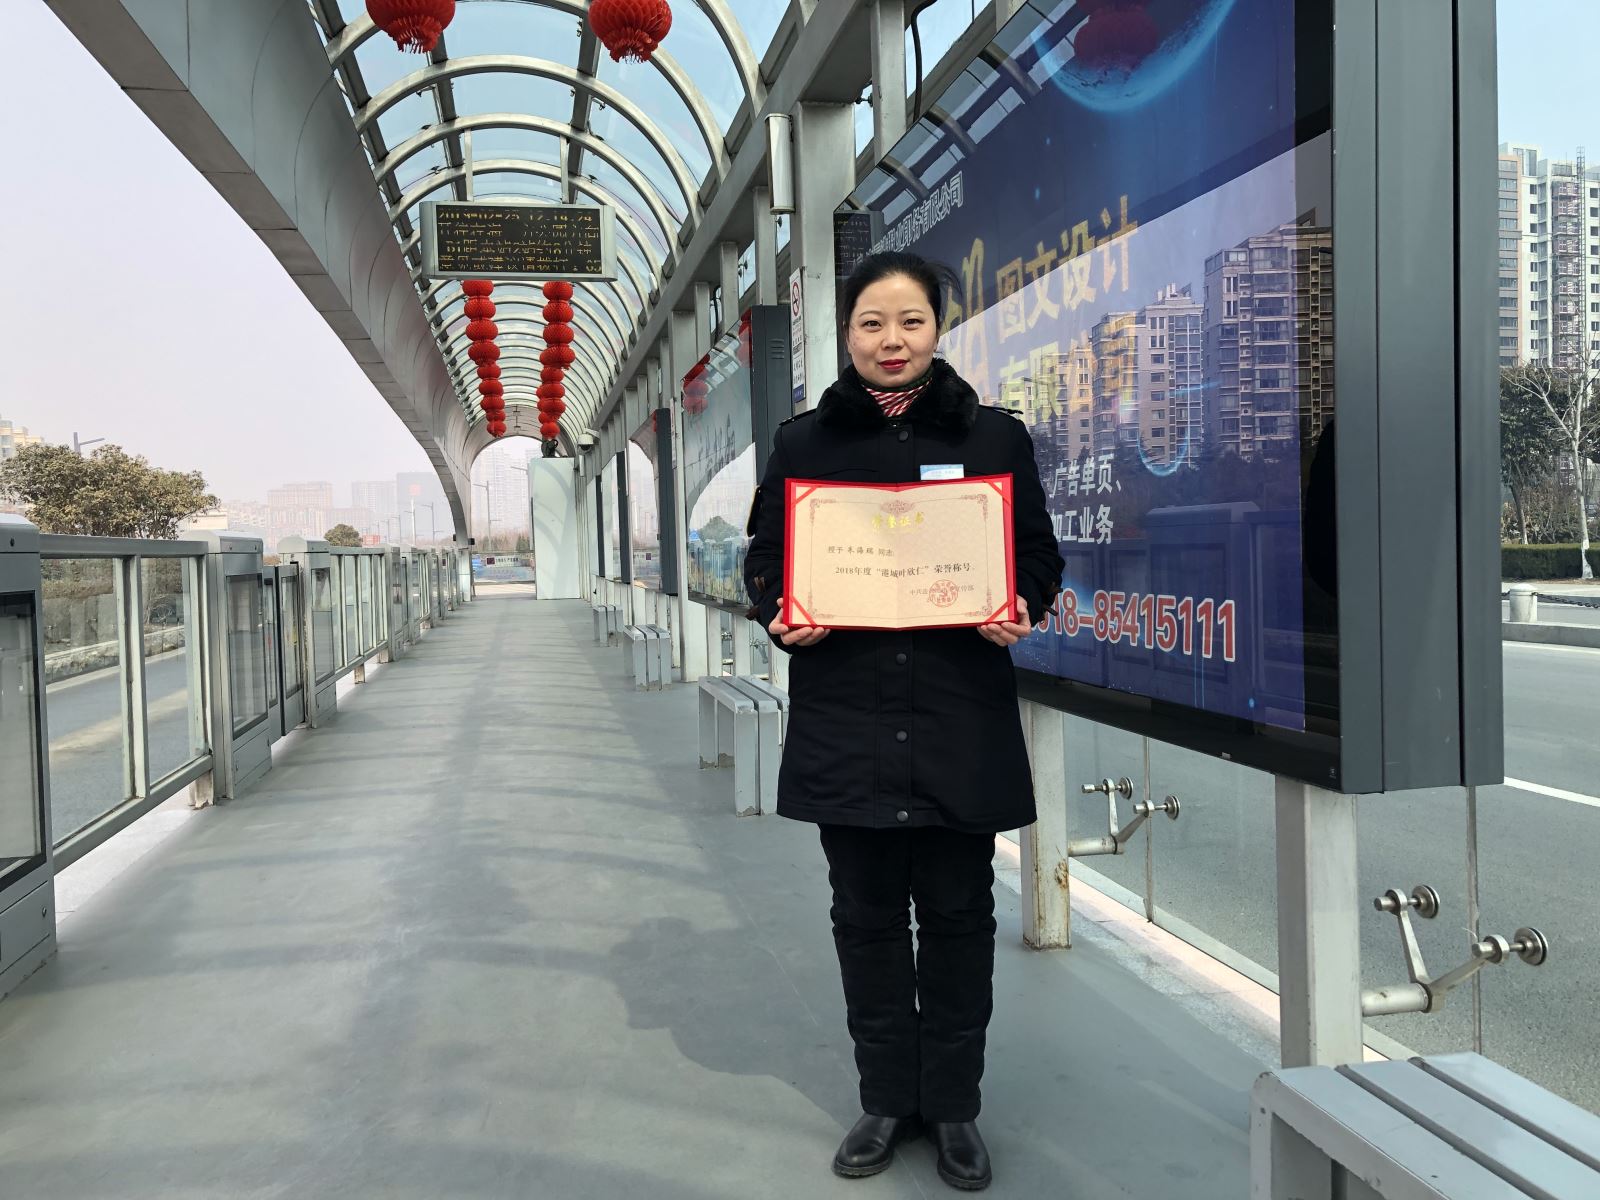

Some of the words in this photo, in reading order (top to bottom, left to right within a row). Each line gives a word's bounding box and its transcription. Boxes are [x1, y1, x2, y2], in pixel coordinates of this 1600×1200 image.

[997, 195, 1138, 342] 图文设计
[1031, 588, 1236, 662] 18-85415111
